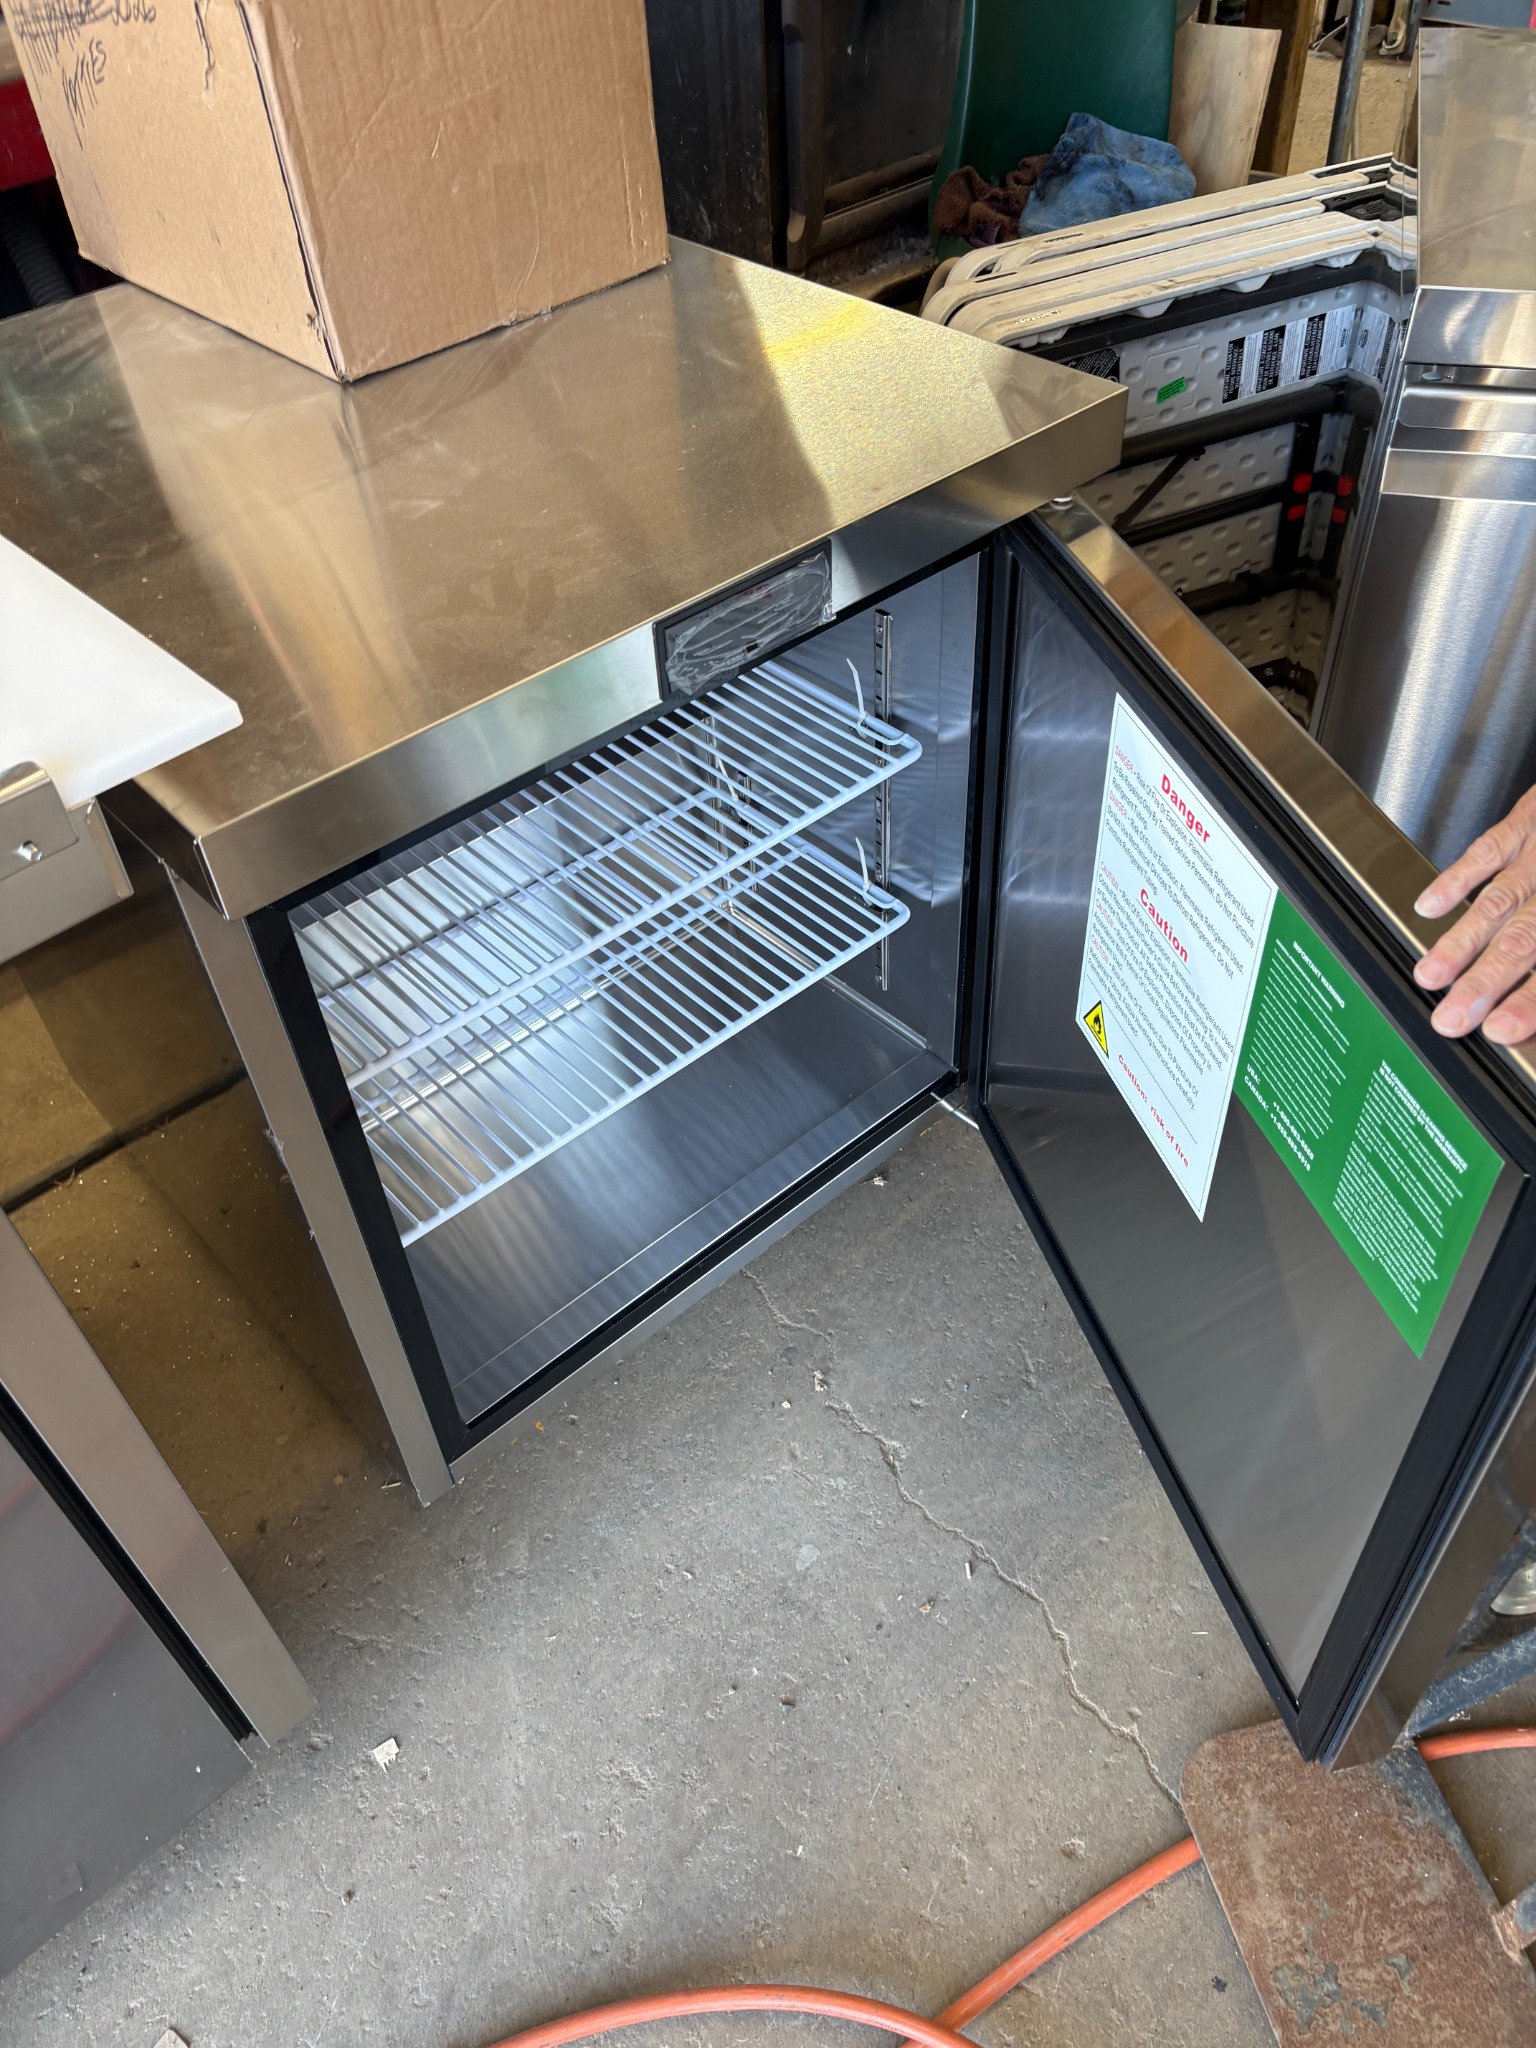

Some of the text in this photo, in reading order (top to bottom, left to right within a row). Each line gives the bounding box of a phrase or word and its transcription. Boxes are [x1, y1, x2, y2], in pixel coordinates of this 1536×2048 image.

[1161, 772, 1210, 843] Danger
[1139, 885, 1188, 963] Caution
[1292, 940, 1321, 979] IMPORTANT
[1320, 974, 1345, 1009] WARNING
[1244, 1074, 1268, 1112] CANADA:
[1246, 1062, 1260, 1086] USA:
[1118, 1052, 1188, 1168] Caution: risk of fire
